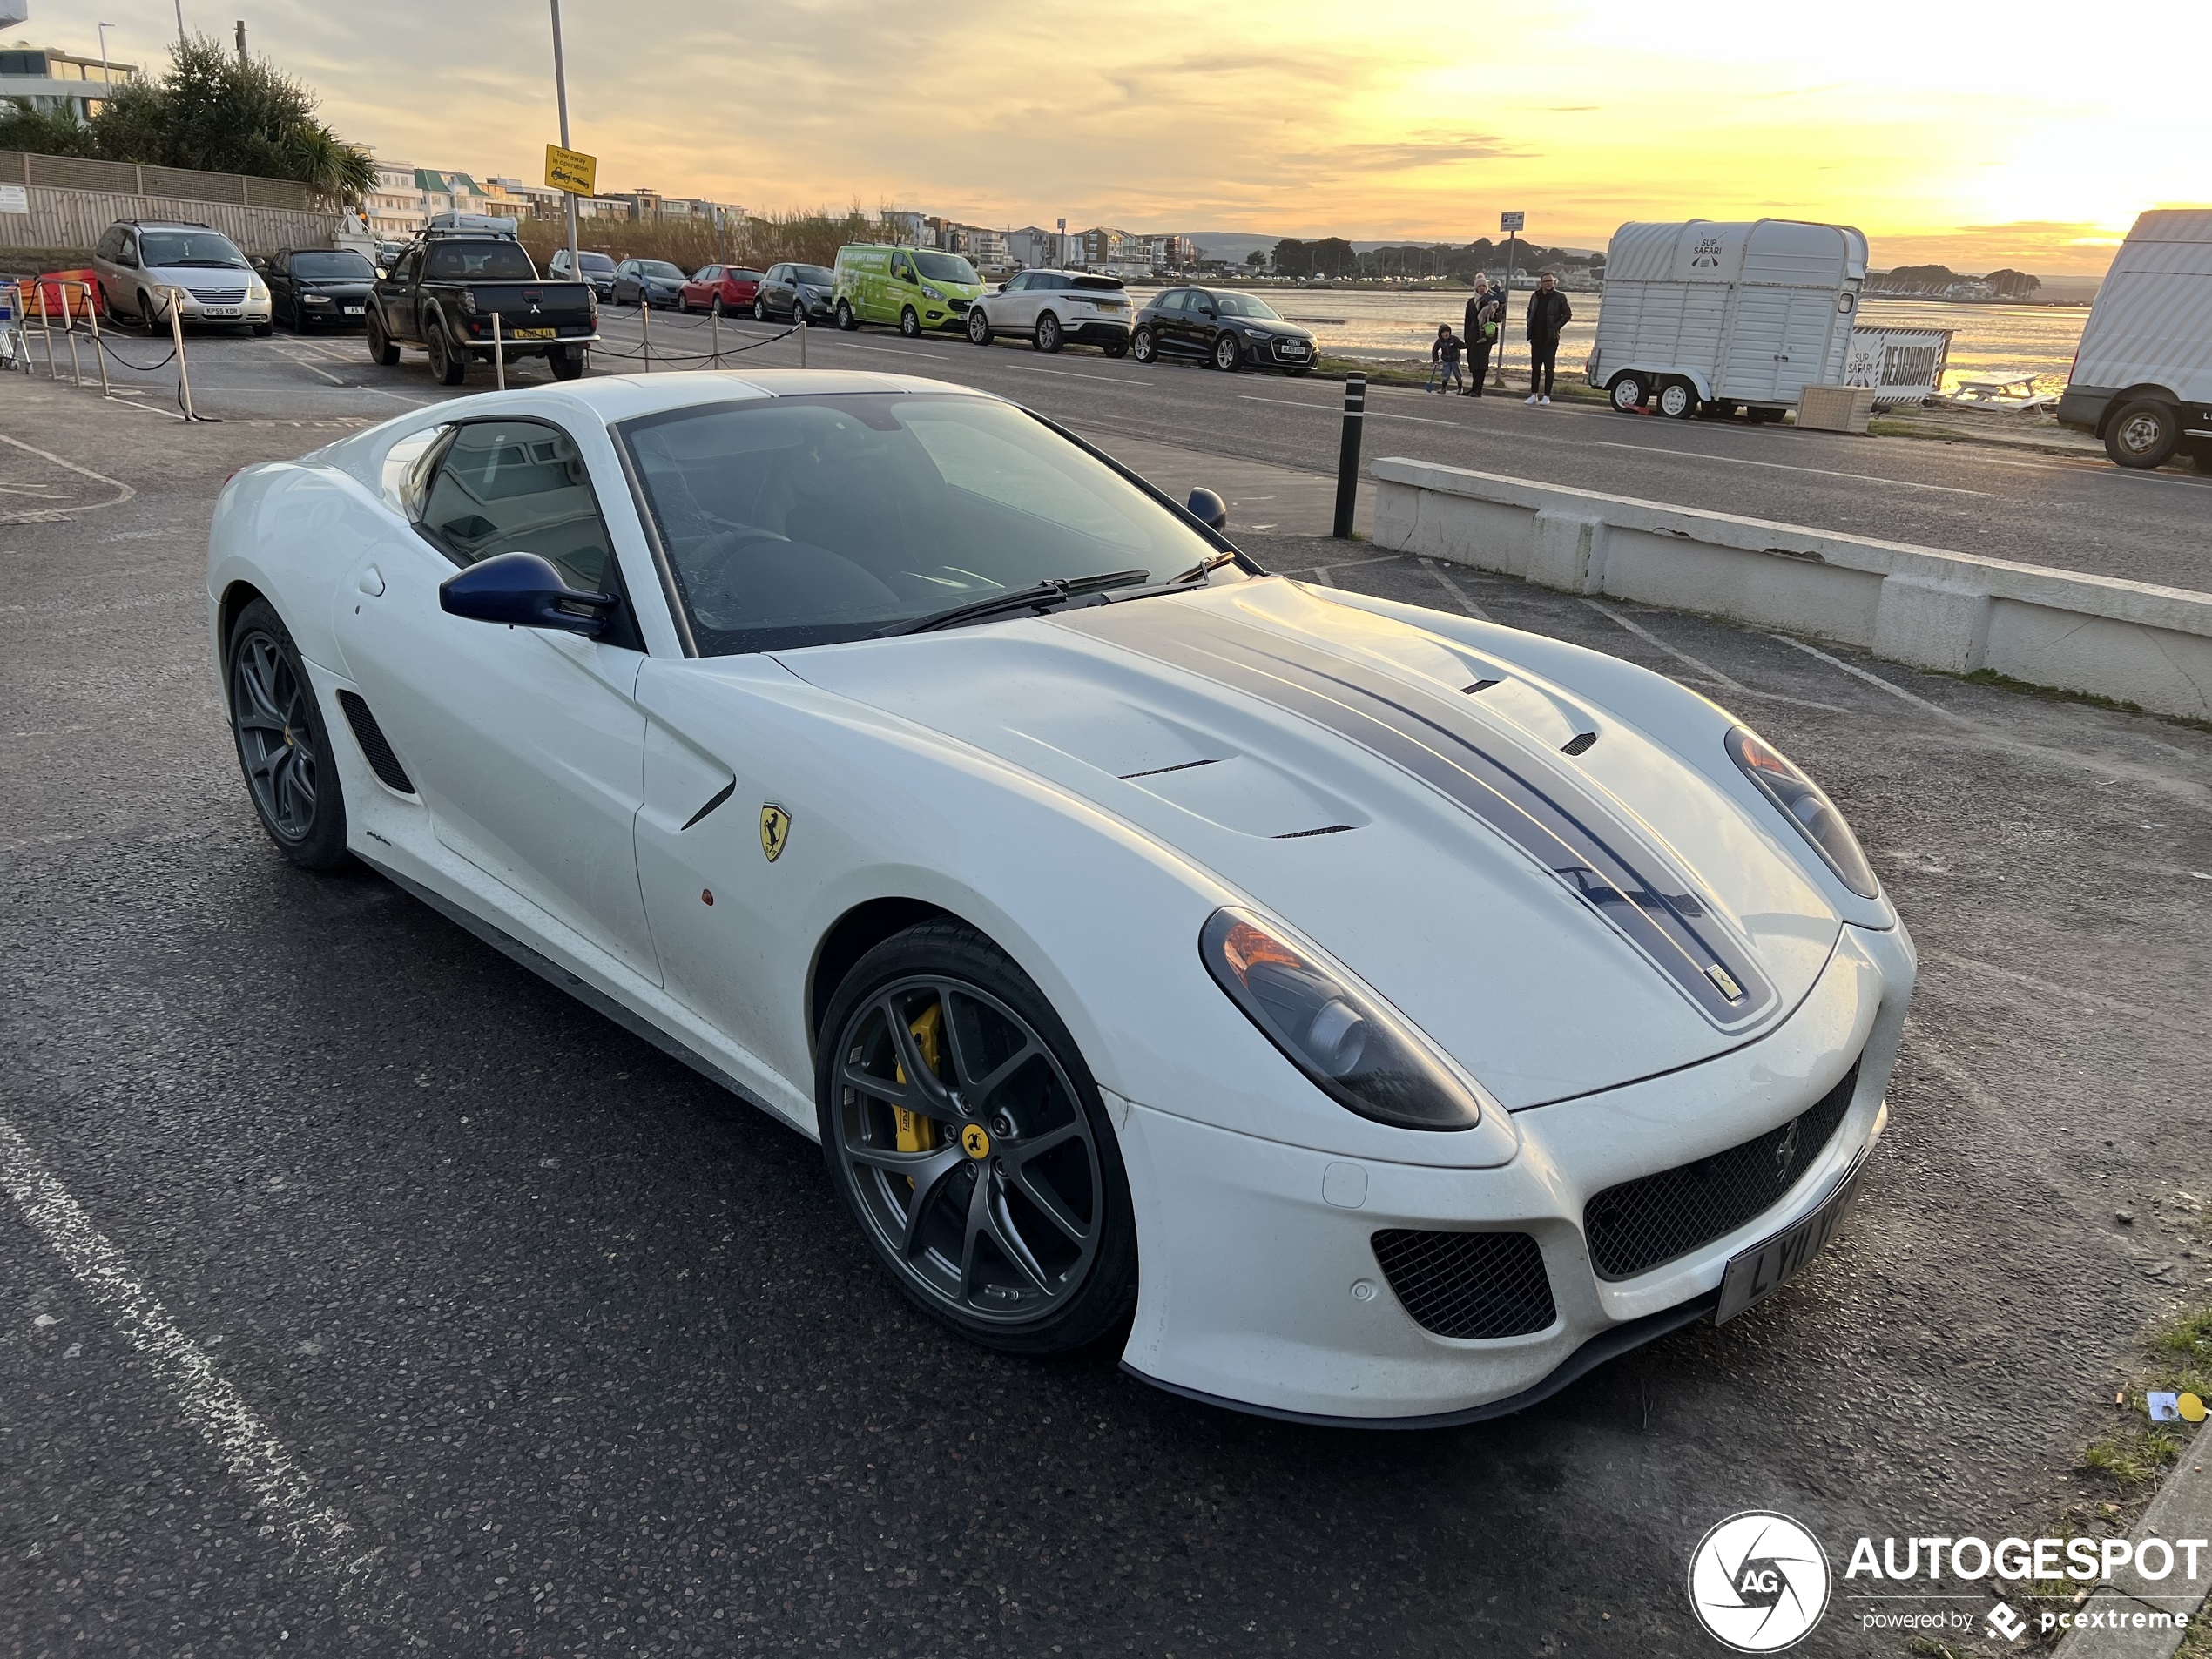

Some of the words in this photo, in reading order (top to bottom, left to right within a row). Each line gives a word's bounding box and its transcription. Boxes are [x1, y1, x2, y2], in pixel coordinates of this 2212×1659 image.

[556, 150, 569, 159] Tow
[570, 156, 586, 165] away
[560, 160, 589, 172] operation
[1693, 246, 1722, 255] SAFARI
[1855, 353, 1870, 362] SUP
[1847, 363, 1873, 374] SAFARI
